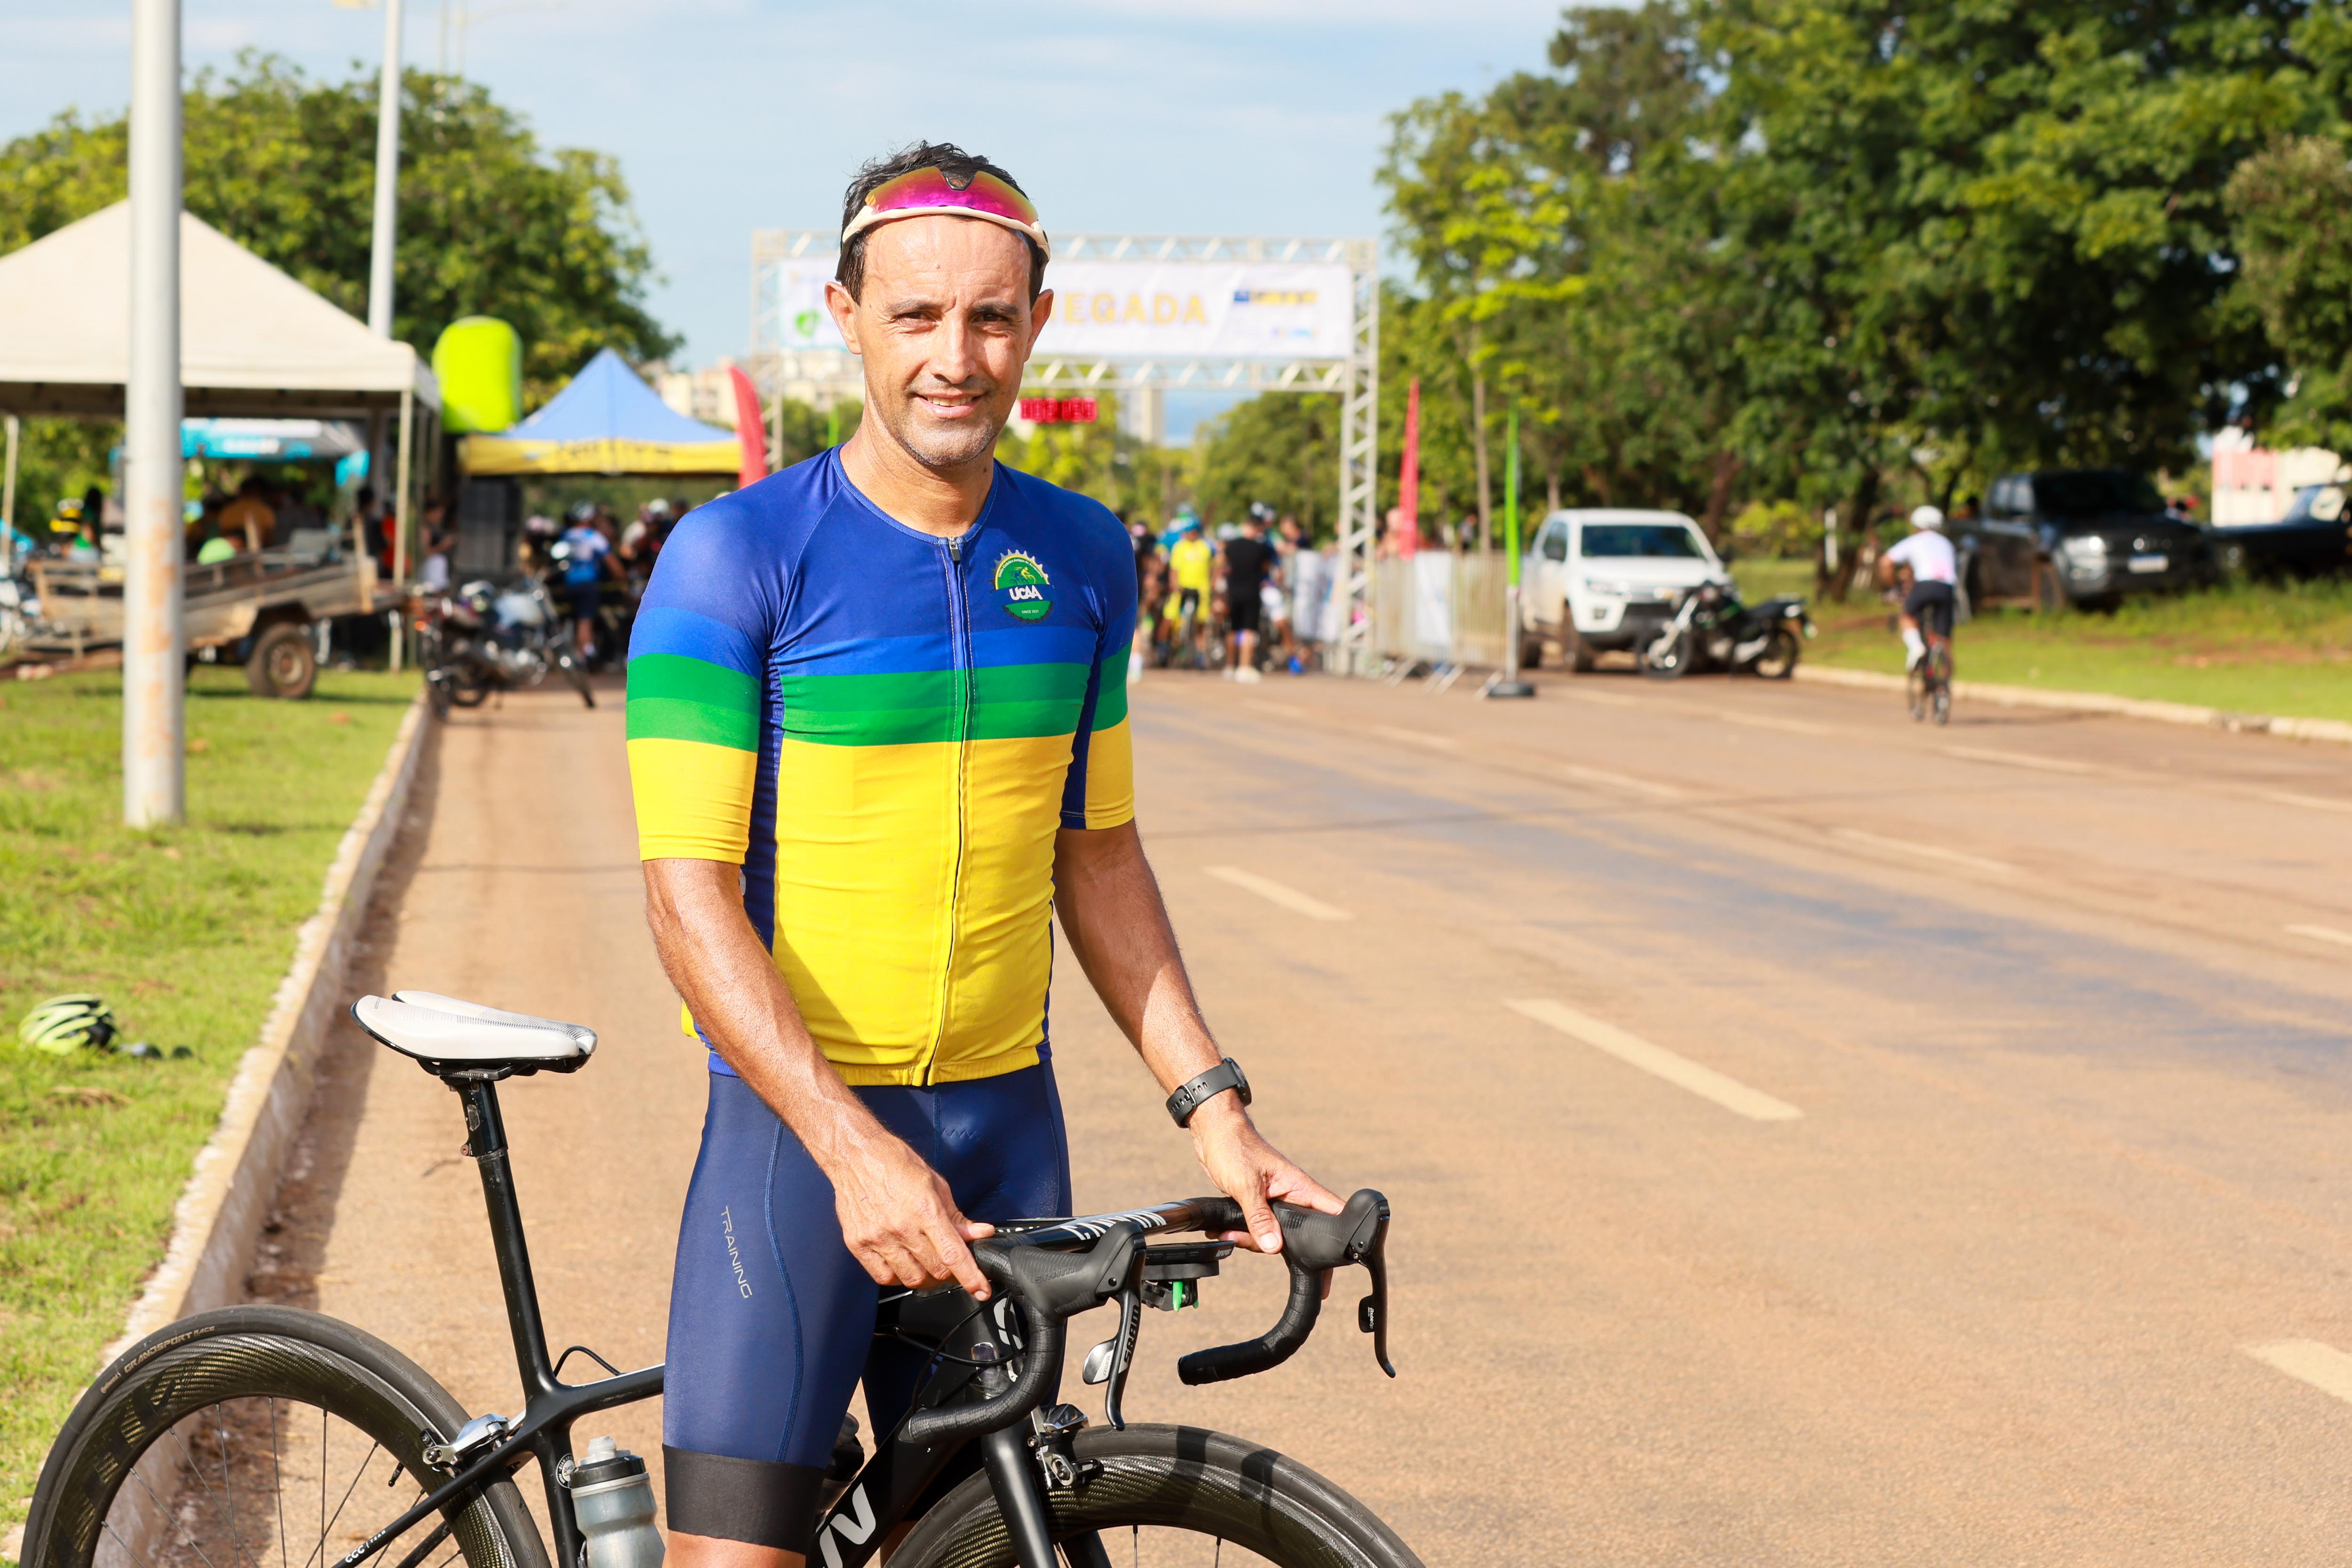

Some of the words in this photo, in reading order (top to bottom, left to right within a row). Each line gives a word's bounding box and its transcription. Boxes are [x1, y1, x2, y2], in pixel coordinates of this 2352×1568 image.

[1049, 293, 1208, 324] EGADA
[1009, 585, 1043, 601] UCAA
[721, 1205, 753, 1299] TRAINING
[124, 1331, 192, 1374] GRANDSPORT
[193, 1326, 215, 1337] RACE
[1103, 1354, 1111, 1376] RIVAL
[345, 1544, 365, 1563] CCC
[370, 1529, 386, 1543] TEAM
